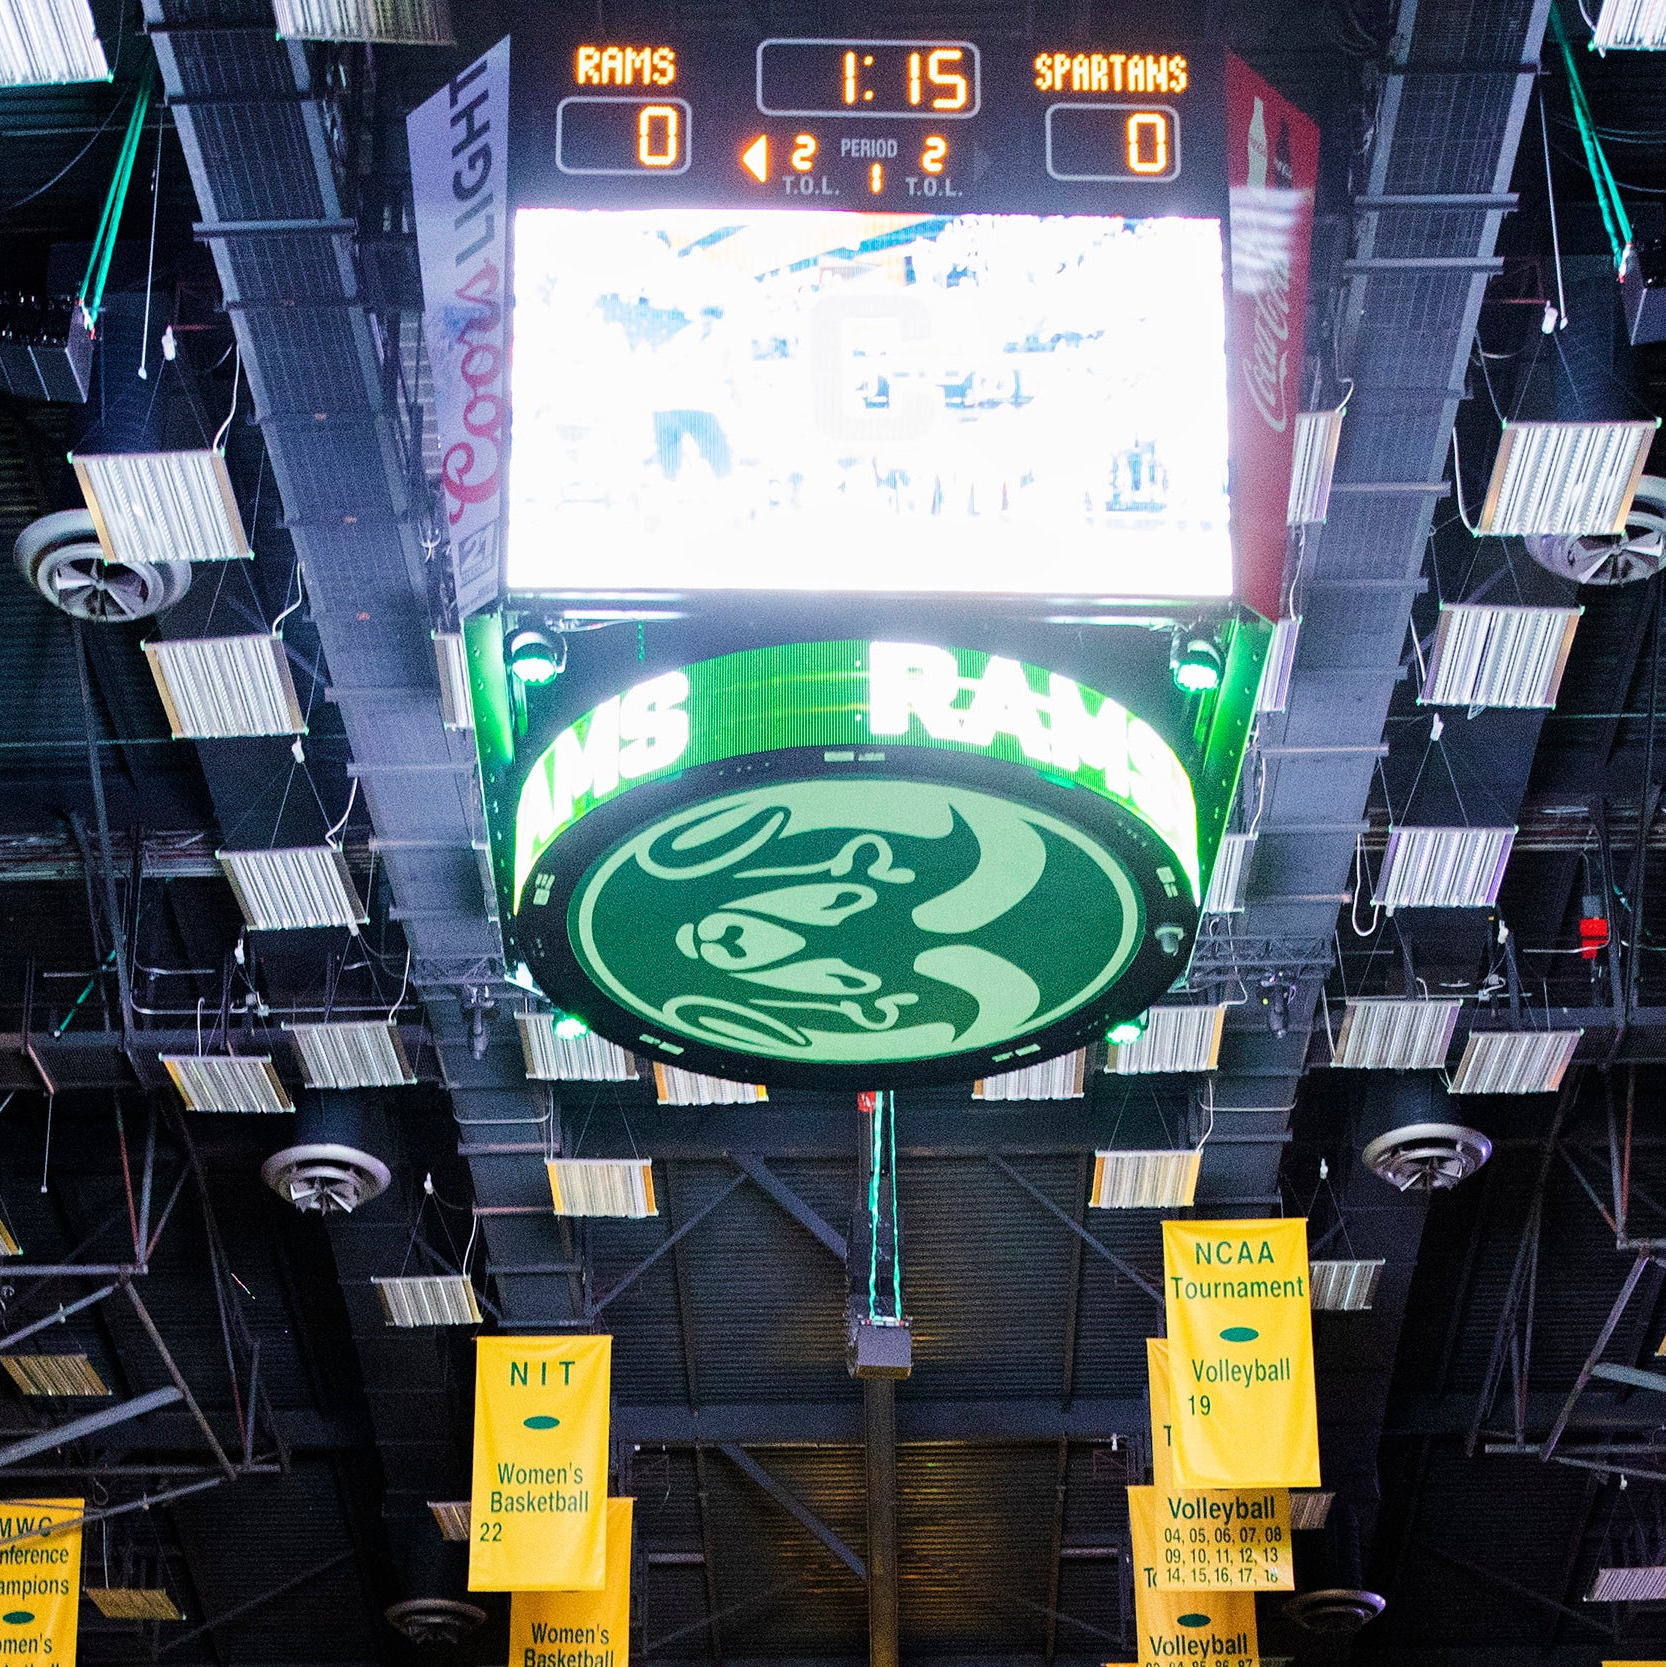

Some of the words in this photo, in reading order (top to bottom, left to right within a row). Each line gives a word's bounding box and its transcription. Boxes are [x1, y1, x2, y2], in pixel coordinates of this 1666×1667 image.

[576, 47, 677, 86] RAMS
[1034, 54, 1188, 93] SPARTANS
[843, 50, 968, 111] 1:15
[638, 106, 677, 166] 0
[840, 138, 898, 159] PERIOD
[1127, 113, 1166, 173] 0
[450, 60, 495, 267] LIGHT
[791, 134, 816, 172] 2
[922, 136, 947, 173] 2
[781, 177, 840, 196] T.O.L.
[869, 163, 883, 193] 1
[905, 178, 963, 198] T.O.L.
[442, 258, 501, 525] Coors
[869, 640, 1199, 878] RAMS
[1195, 1240, 1274, 1265] NCAA
[1170, 1275, 1304, 1300] Tournament
[510, 1361, 575, 1387] NIT
[1191, 1357, 1291, 1389] Volleyball
[1188, 1394, 1211, 1416] 19
[497, 1462, 583, 1485] Women's
[490, 1490, 589, 1513] Basketball
[1168, 1497, 1275, 1525] Volleyball
[480, 1522, 502, 1542] 22
[1164, 1527, 1185, 1546] 04,
[1189, 1527, 1210, 1546] 05,
[1214, 1526, 1235, 1545] 06,
[1239, 1526, 1260, 1545] 07,
[1264, 1525, 1282, 1543] 08
[1164, 1548, 1186, 1567] 09,
[1190, 1548, 1210, 1566] 10,
[1262, 1547, 1279, 1563] 13
[1190, 1567, 1211, 1585] 15,
[1214, 1567, 1235, 1585] 16,
[531, 1623, 609, 1645] Women's
[1149, 1633, 1248, 1660] Volleyball
